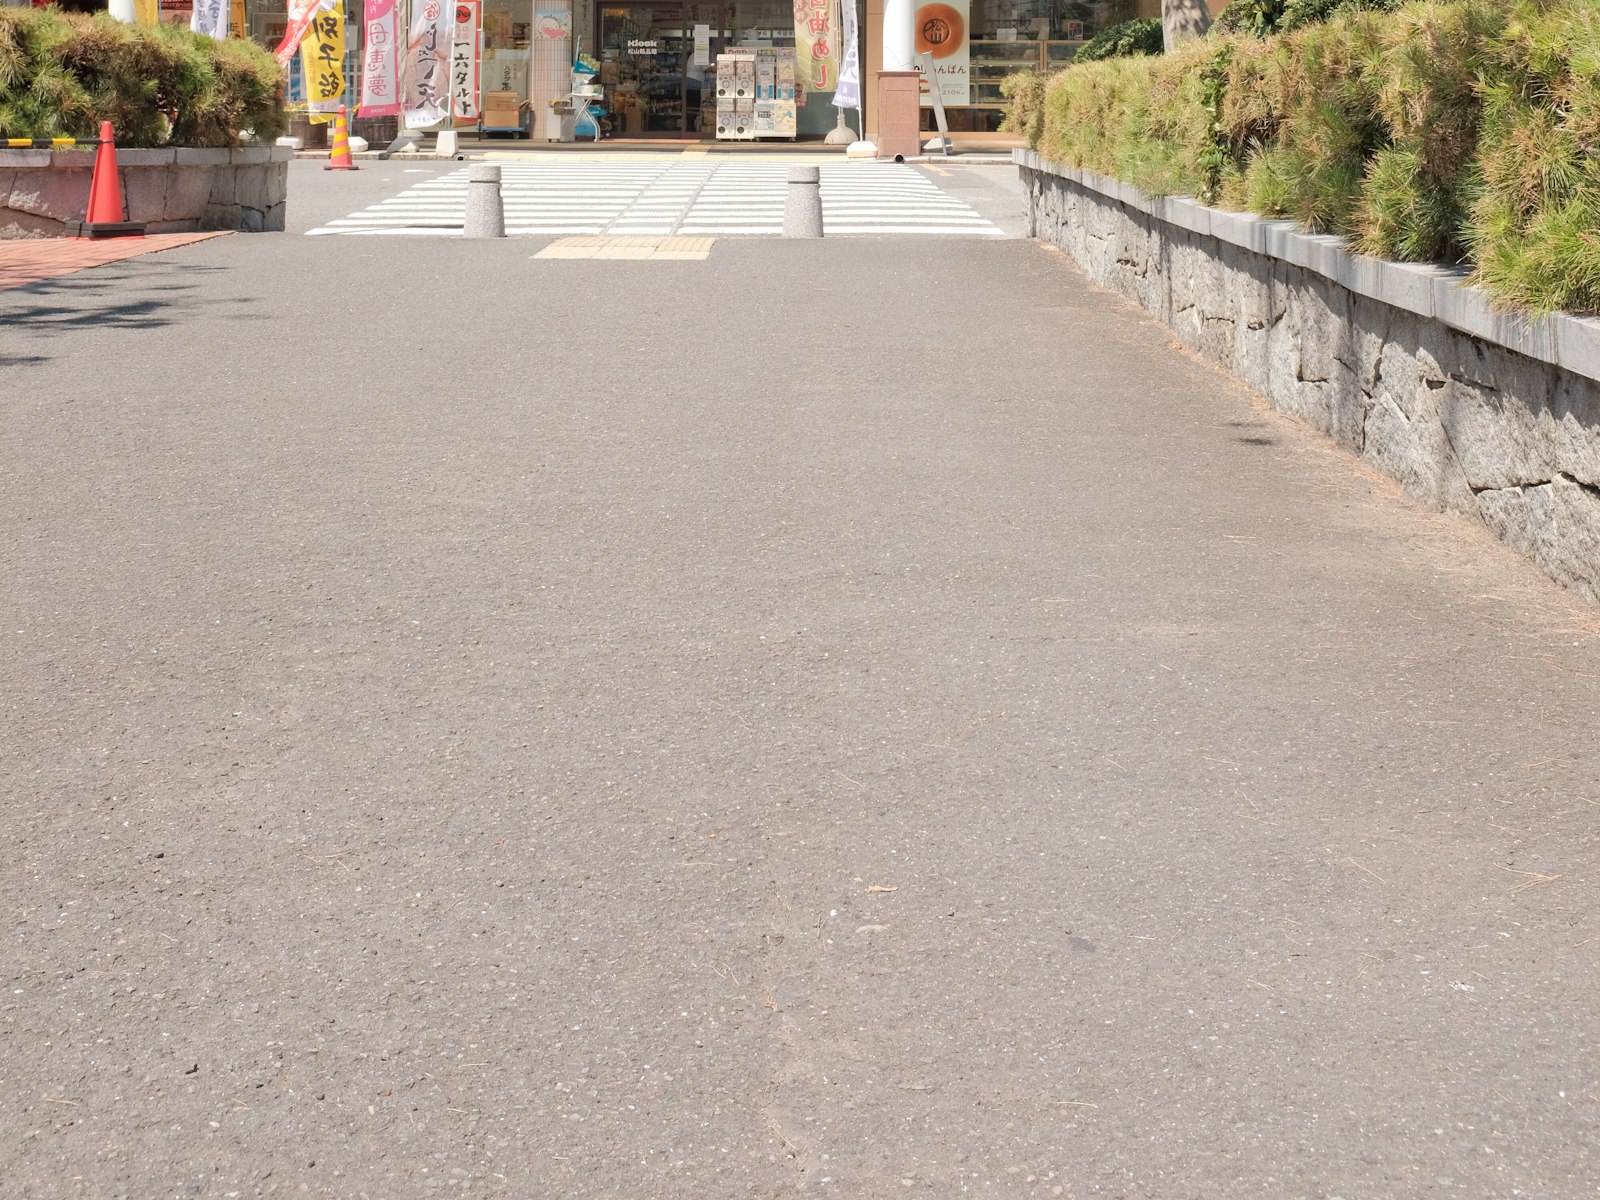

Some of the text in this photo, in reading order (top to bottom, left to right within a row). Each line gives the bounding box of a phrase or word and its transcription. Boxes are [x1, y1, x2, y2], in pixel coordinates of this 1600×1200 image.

[627, 39, 658, 48] Kiosk
[454, 41, 471, 115] 一六タルト
